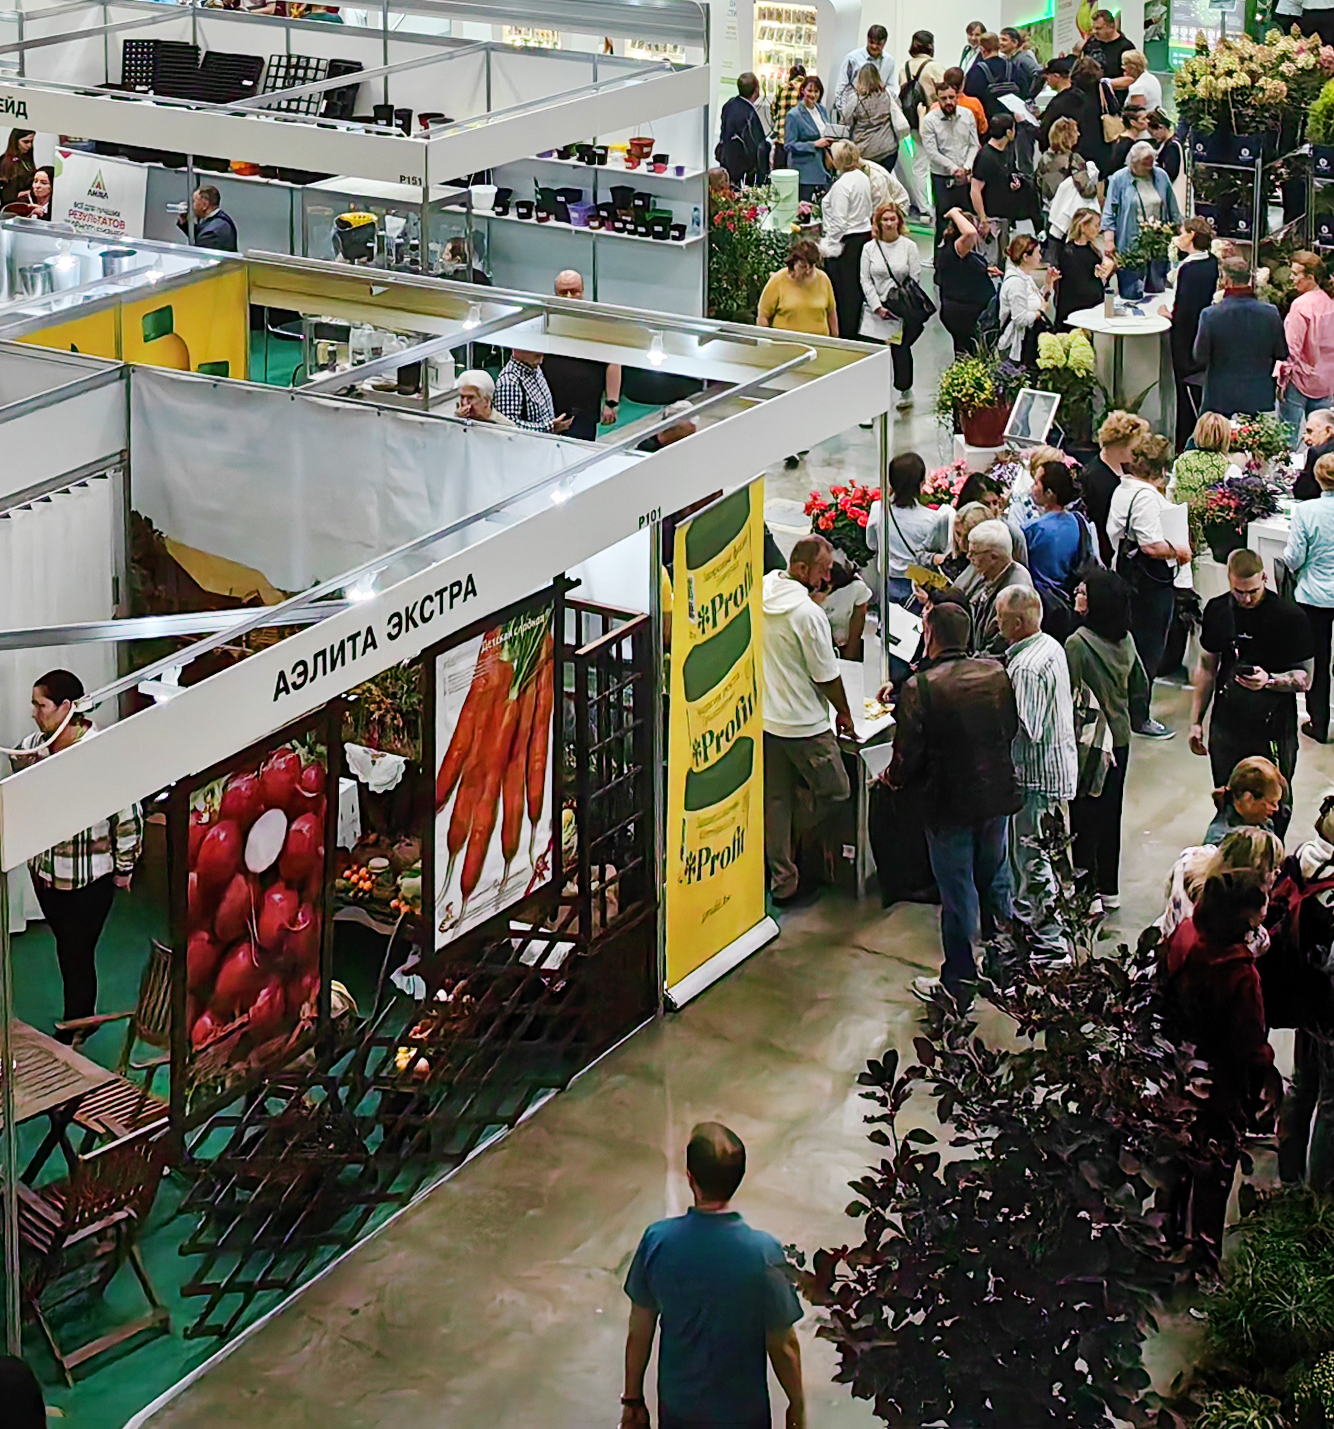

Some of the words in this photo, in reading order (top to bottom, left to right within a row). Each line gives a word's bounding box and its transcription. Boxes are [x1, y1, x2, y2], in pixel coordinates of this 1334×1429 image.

[399, 174, 422, 186] P151
[68, 208, 126, 230] РЕЗУЛЬТАТОВ
[638, 506, 662, 528] P101
[273, 625, 378, 703] АЭЛИТА
[386, 574, 479, 641] ЭКСТРА
